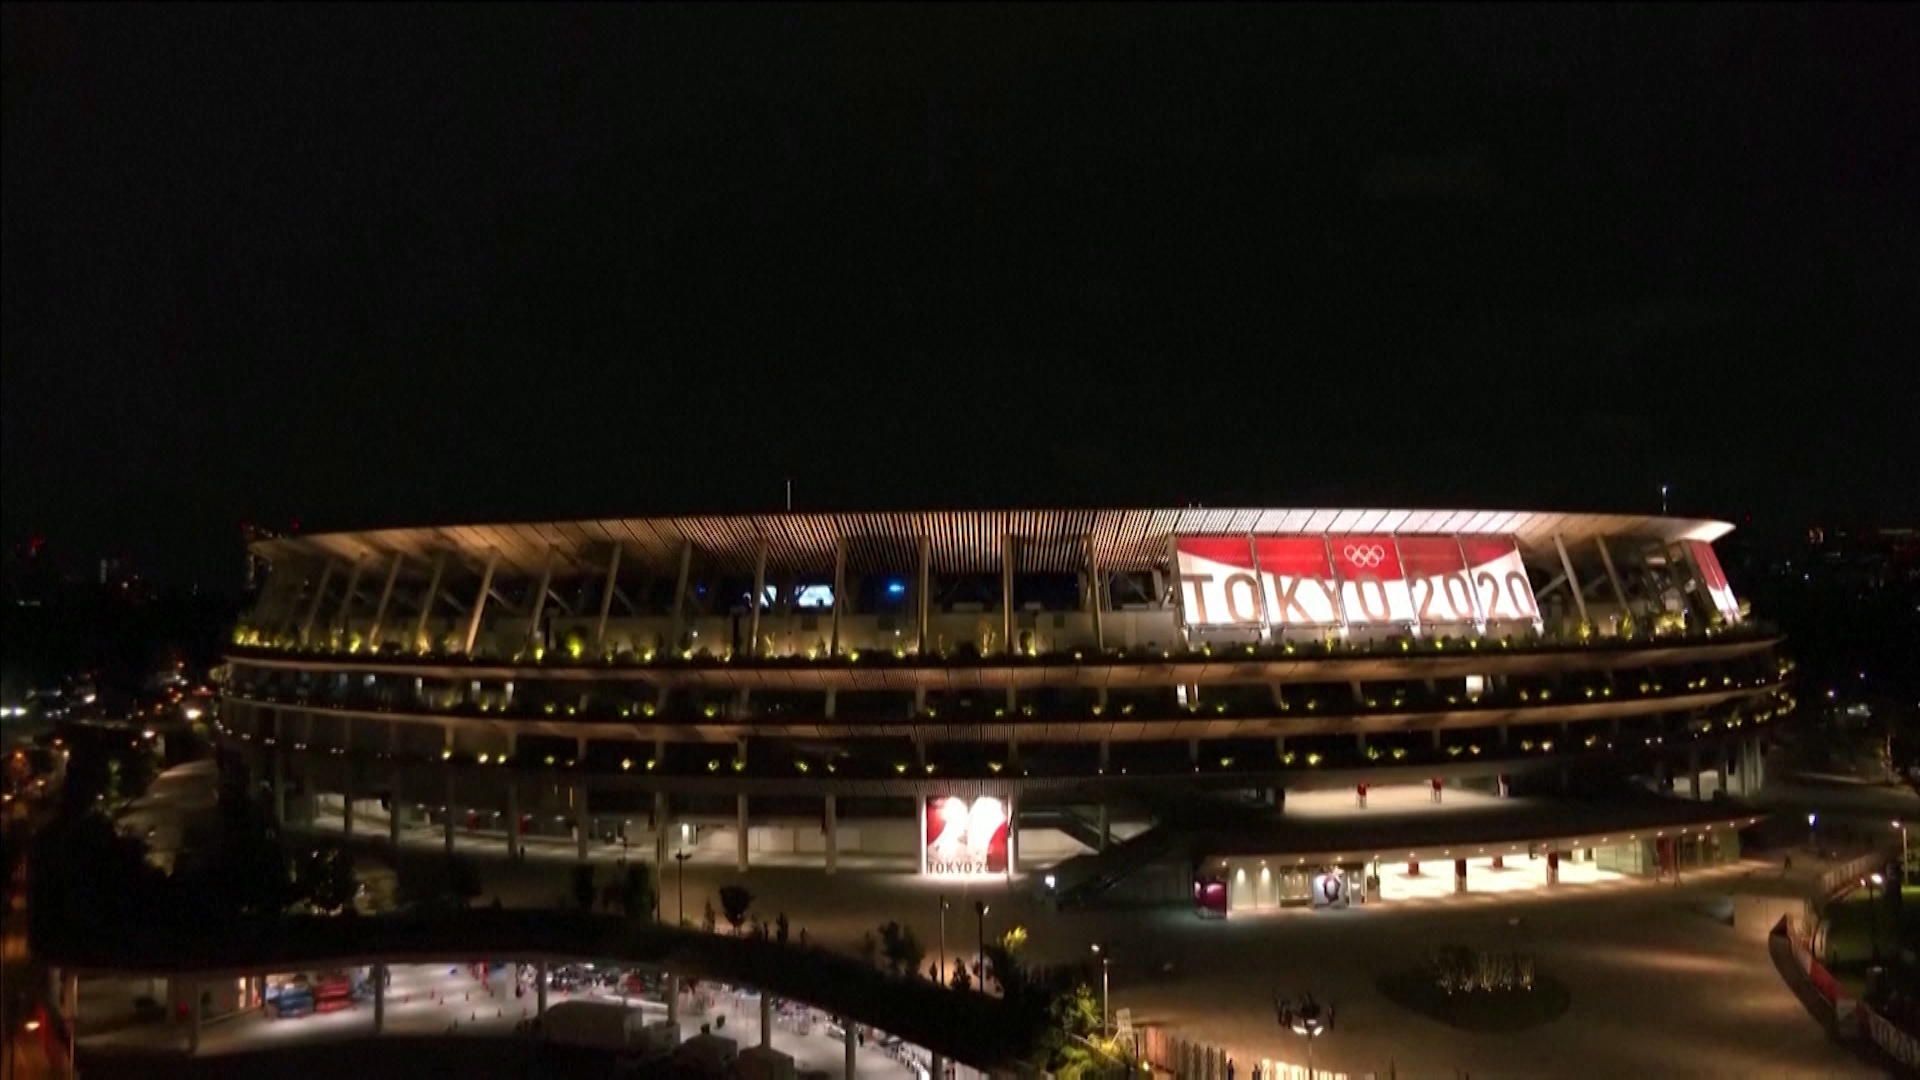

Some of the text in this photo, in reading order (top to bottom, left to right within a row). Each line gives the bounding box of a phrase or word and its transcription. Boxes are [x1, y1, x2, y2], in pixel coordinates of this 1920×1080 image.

[1182, 570, 1537, 623] TOKYO 2020
[928, 861, 973, 874] TOKYO
